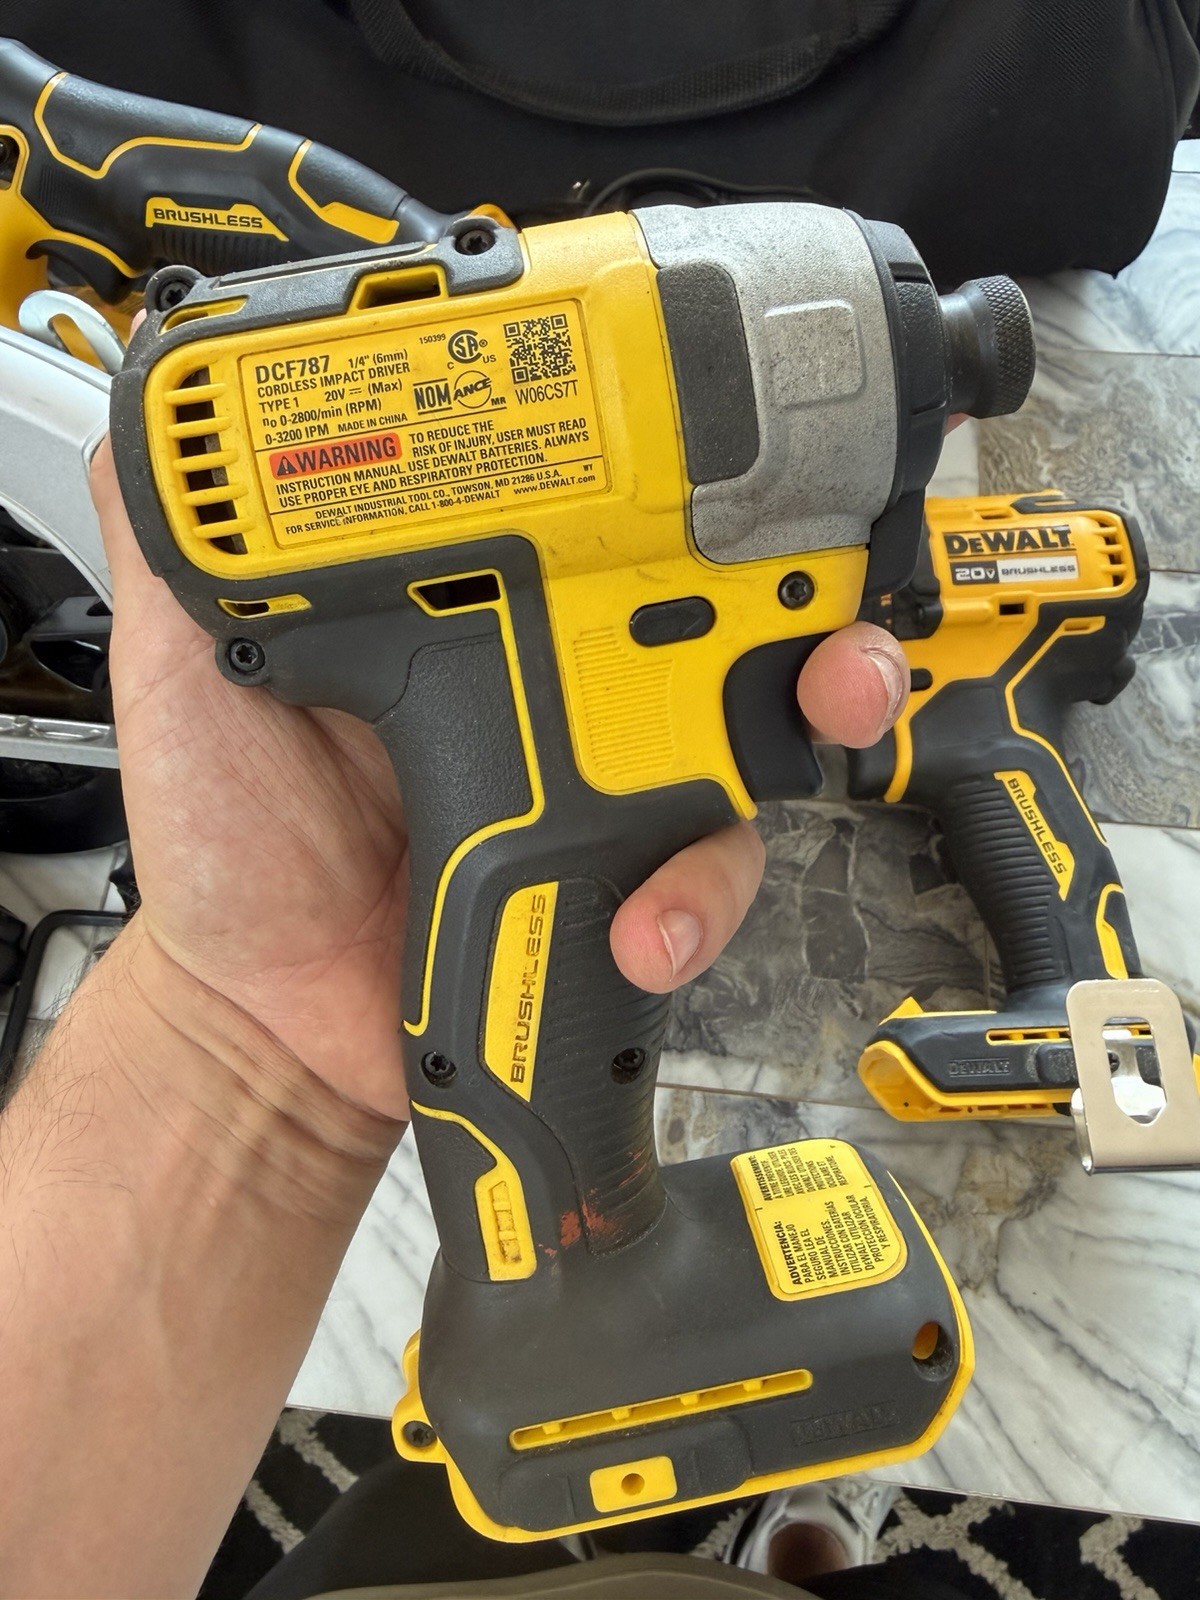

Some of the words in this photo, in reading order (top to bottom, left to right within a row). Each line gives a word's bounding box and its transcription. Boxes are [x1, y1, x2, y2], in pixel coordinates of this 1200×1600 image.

[153, 208, 263, 228] BRUSHLESS
[419, 333, 446, 344] 150399
[255, 355, 329, 384] DCF787
[348, 354, 370, 369] 1/4"
[372, 348, 408, 365] (6mm)
[482, 354, 497, 364] US
[257, 378, 317, 398] CORDLESS
[319, 369, 365, 387] IMPACT
[368, 362, 410, 379] DRIVER
[324, 388, 345, 402] 20V
[367, 378, 402, 396] (Max)
[453, 377, 493, 400] ANCE
[515, 379, 577, 405] W06CS7T
[258, 397, 291, 413] TYPE
[292, 396, 299, 408] 1
[414, 383, 451, 410] NOM
[490, 396, 506, 406] MR
[279, 406, 342, 426] 0-2800/min
[345, 398, 381, 416] (RPM)
[337, 419, 365, 432] MADE
[366, 418, 377, 428] IN
[378, 412, 408, 425] CHINA
[265, 428, 302, 445] 0-3200
[304, 423, 329, 438] IPM
[408, 432, 424, 444] TO
[426, 424, 470, 441] REDUCE
[471, 419, 494, 433] THE
[412, 443, 437, 458] RISK
[438, 440, 452, 453] OF
[453, 433, 494, 450] INJURY,
[496, 428, 524, 443] USER
[525, 422, 555, 437] MUST
[558, 417, 586, 432] READ
[276, 472, 351, 495] INSTRUCTION
[407, 458, 430, 472] USE
[432, 450, 476, 468] DEWALT
[479, 439, 541, 459] BATTERIES.
[544, 430, 589, 448] ALWAYS
[295, 437, 396, 472] WARNING
[279, 494, 302, 508] USE
[303, 487, 348, 504] PROPER
[349, 482, 370, 496] EYE
[373, 478, 397, 492] AND
[399, 465, 472, 487] RESPIRATORY
[476, 452, 547, 473] PROTECTION.
[513, 475, 595, 494] www.DEWALT.com
[315, 505, 351, 519] DEWALT
[353, 496, 407, 512] INDUSTRIAL
[408, 492, 432, 503] TOOL
[451, 481, 493, 495] TOWSON,
[494, 477, 510, 487] MD
[511, 473, 535, 485] 21286
[285, 524, 303, 534] FOR
[304, 518, 341, 531] SERVICE
[408, 502, 431, 513] CALL
[432, 489, 499, 509] 1-800-4-DEWALT
[1001, 564, 1076, 575] BRUSHLESS
[1007, 778, 1067, 874] BRUSHLESS
[510, 894, 546, 1083] BRUSHLESS
[785, 1223, 803, 1252] MANEJO
[799, 1228, 810, 1237] EL
[802, 1237, 815, 1251] LEA
[814, 1235, 826, 1246] DE
[836, 1229, 850, 1243] CON
[774, 1221, 802, 1285] ADVERTENCIA:
[796, 1252, 807, 1262] EL
[808, 1251, 826, 1280] SEGURO
[819, 1245, 838, 1278] MANUAL
[842, 1243, 862, 1273] UTILIZAR
[799, 1262, 815, 1283] PARA
